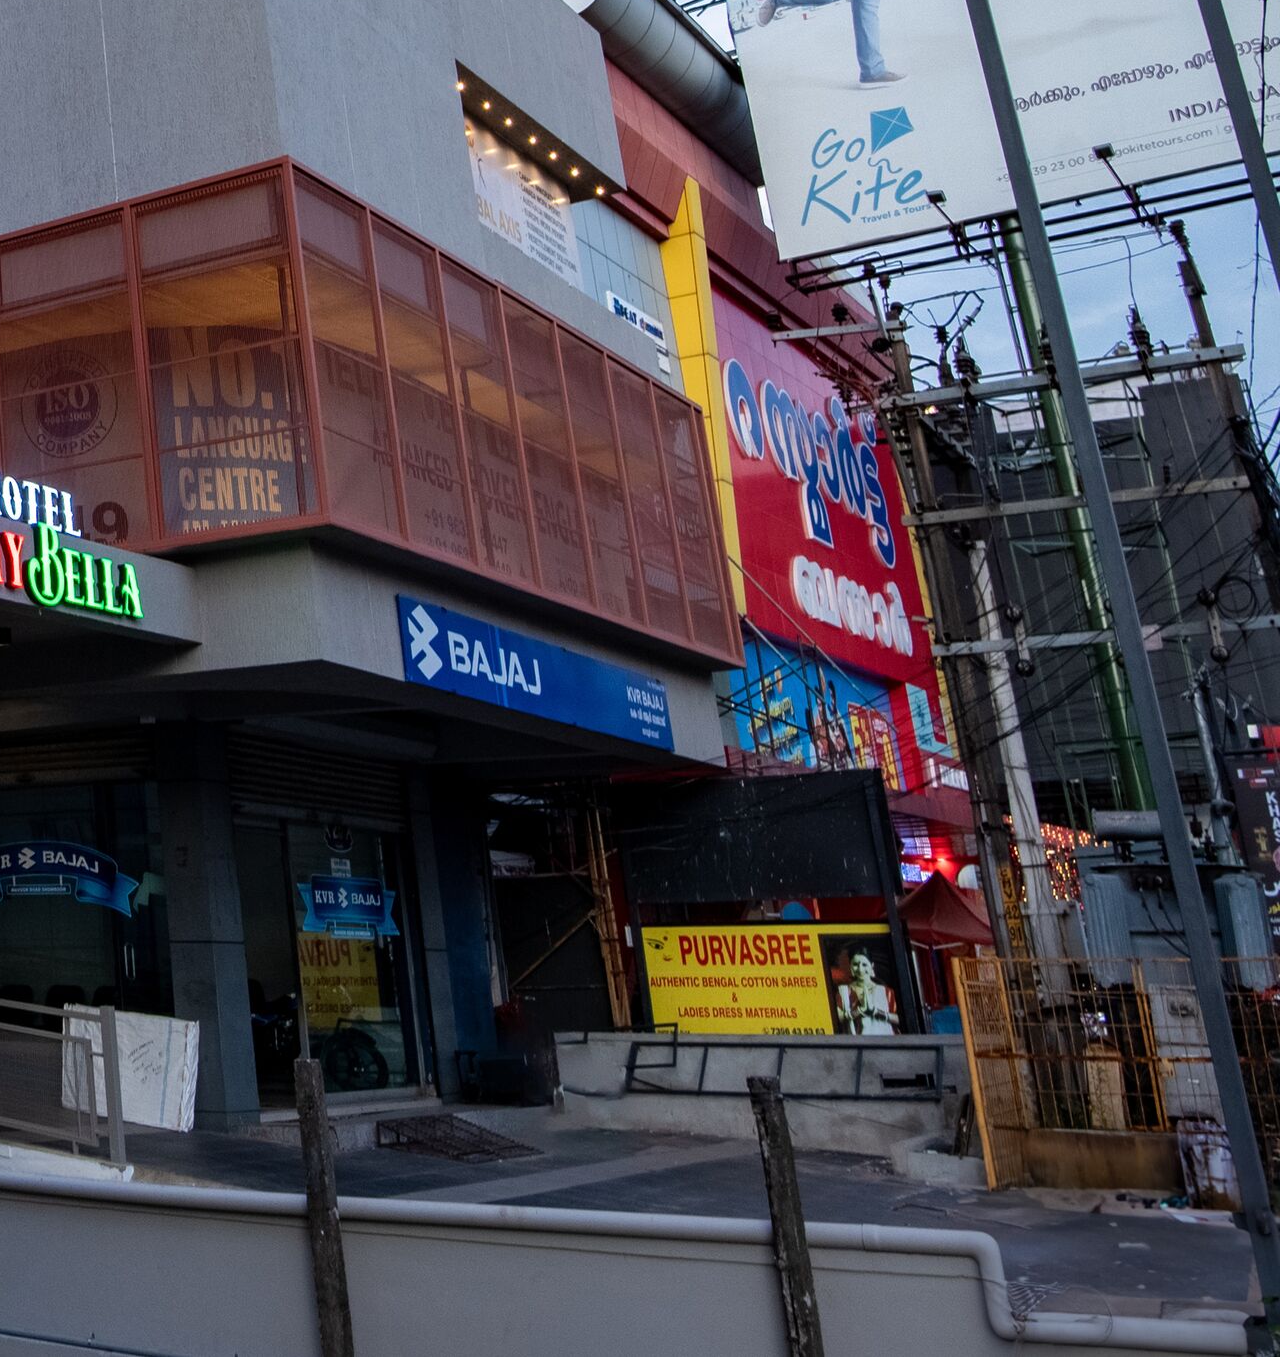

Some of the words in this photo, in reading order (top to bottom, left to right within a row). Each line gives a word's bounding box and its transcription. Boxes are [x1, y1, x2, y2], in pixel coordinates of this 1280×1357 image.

[1169, 98, 1229, 122] INDIA
[811, 128, 865, 169] Go
[801, 166, 927, 226] Kite
[861, 211, 892, 224] Travel
[893, 209, 901, 217] &
[903, 203, 932, 215] Tours
[44, 384, 89, 414] ISO
[36, 420, 110, 453] COMPANY
[178, 466, 281, 512] CENTRE
[26, 522, 144, 620] BELLA
[446, 629, 542, 697] BAJAJ
[626, 685, 642, 706] KVR
[642, 690, 664, 712] BAJAJ
[42, 850, 101, 874] BAJAJ
[315, 889, 335, 904] KVR
[351, 892, 381, 906] BAJAJ
[678, 933, 814, 967] PURVASREE
[650, 976, 700, 988] AUTHENTIC
[702, 976, 739, 988] BENGAL
[741, 976, 779, 988] COTTON
[781, 976, 818, 988] SAREES
[732, 992, 738, 1003] &
[678, 1007, 710, 1018] LADIES
[712, 1007, 743, 1018] DRESS
[745, 1007, 798, 1018] MATERIALS
